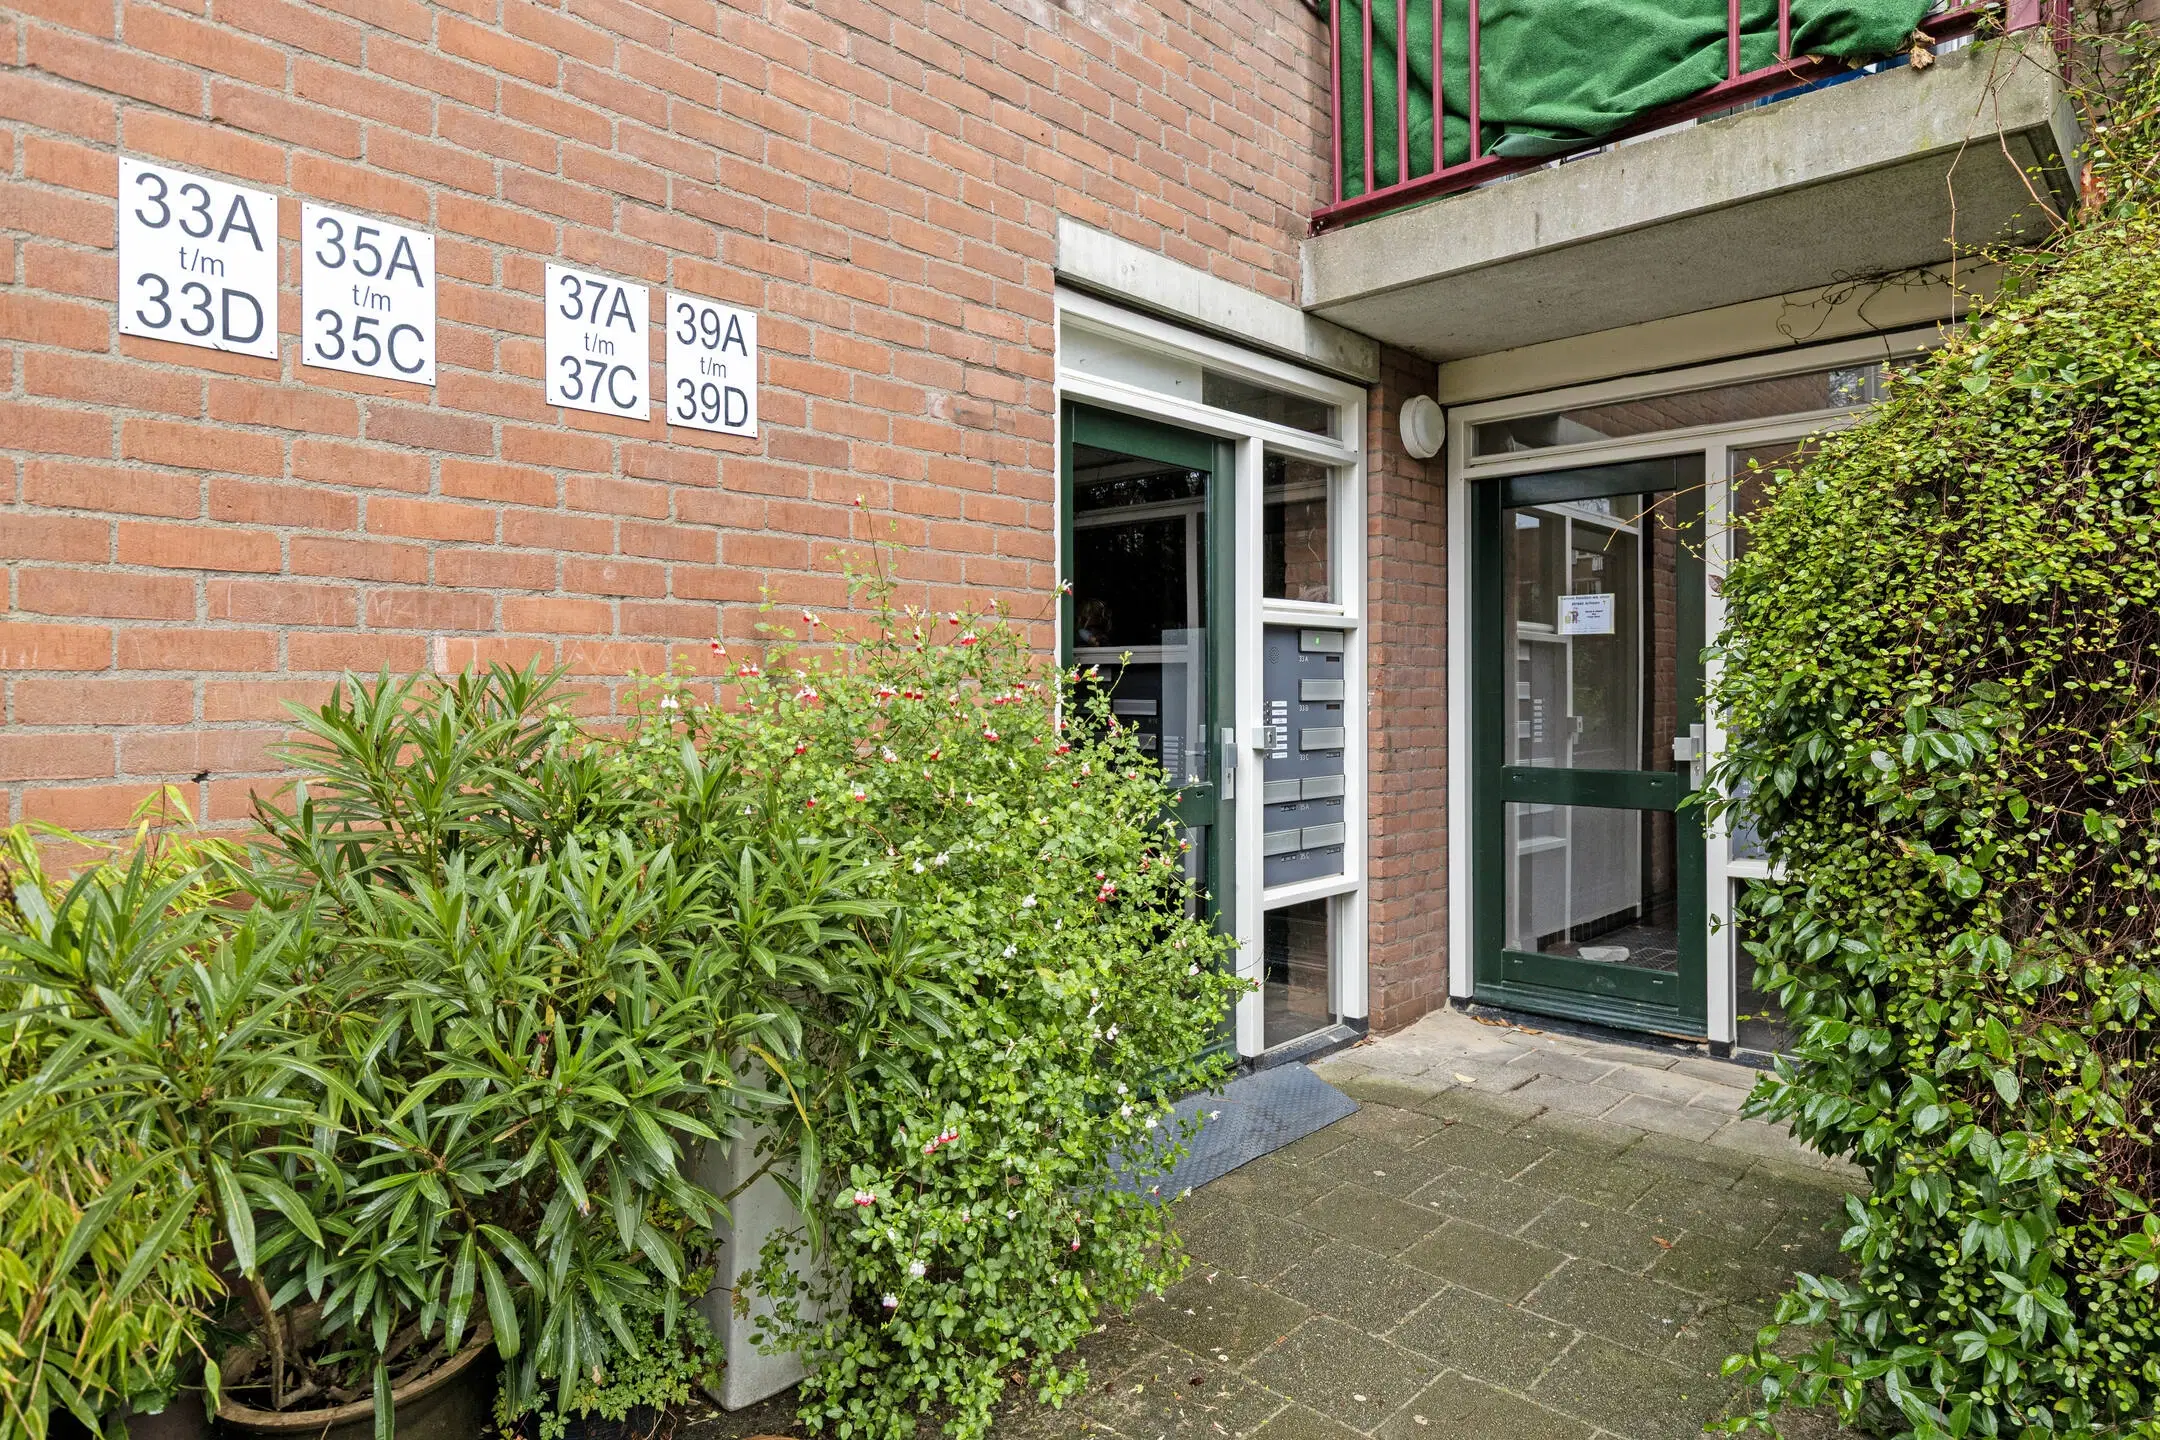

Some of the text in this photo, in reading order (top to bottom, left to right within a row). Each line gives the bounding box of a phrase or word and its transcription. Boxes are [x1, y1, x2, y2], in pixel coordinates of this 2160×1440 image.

[136, 173, 263, 251] 33A
[179, 247, 223, 276] t/m
[316, 217, 424, 287] 35A
[136, 273, 263, 343] 33D
[353, 285, 390, 311] t/m
[560, 275, 635, 332] 37A
[315, 309, 424, 373] 35C
[585, 333, 613, 355] t/m
[677, 303, 747, 356] 39A
[560, 356, 637, 409] 37C
[700, 357, 726, 377] t/m
[677, 378, 748, 427] 39D
